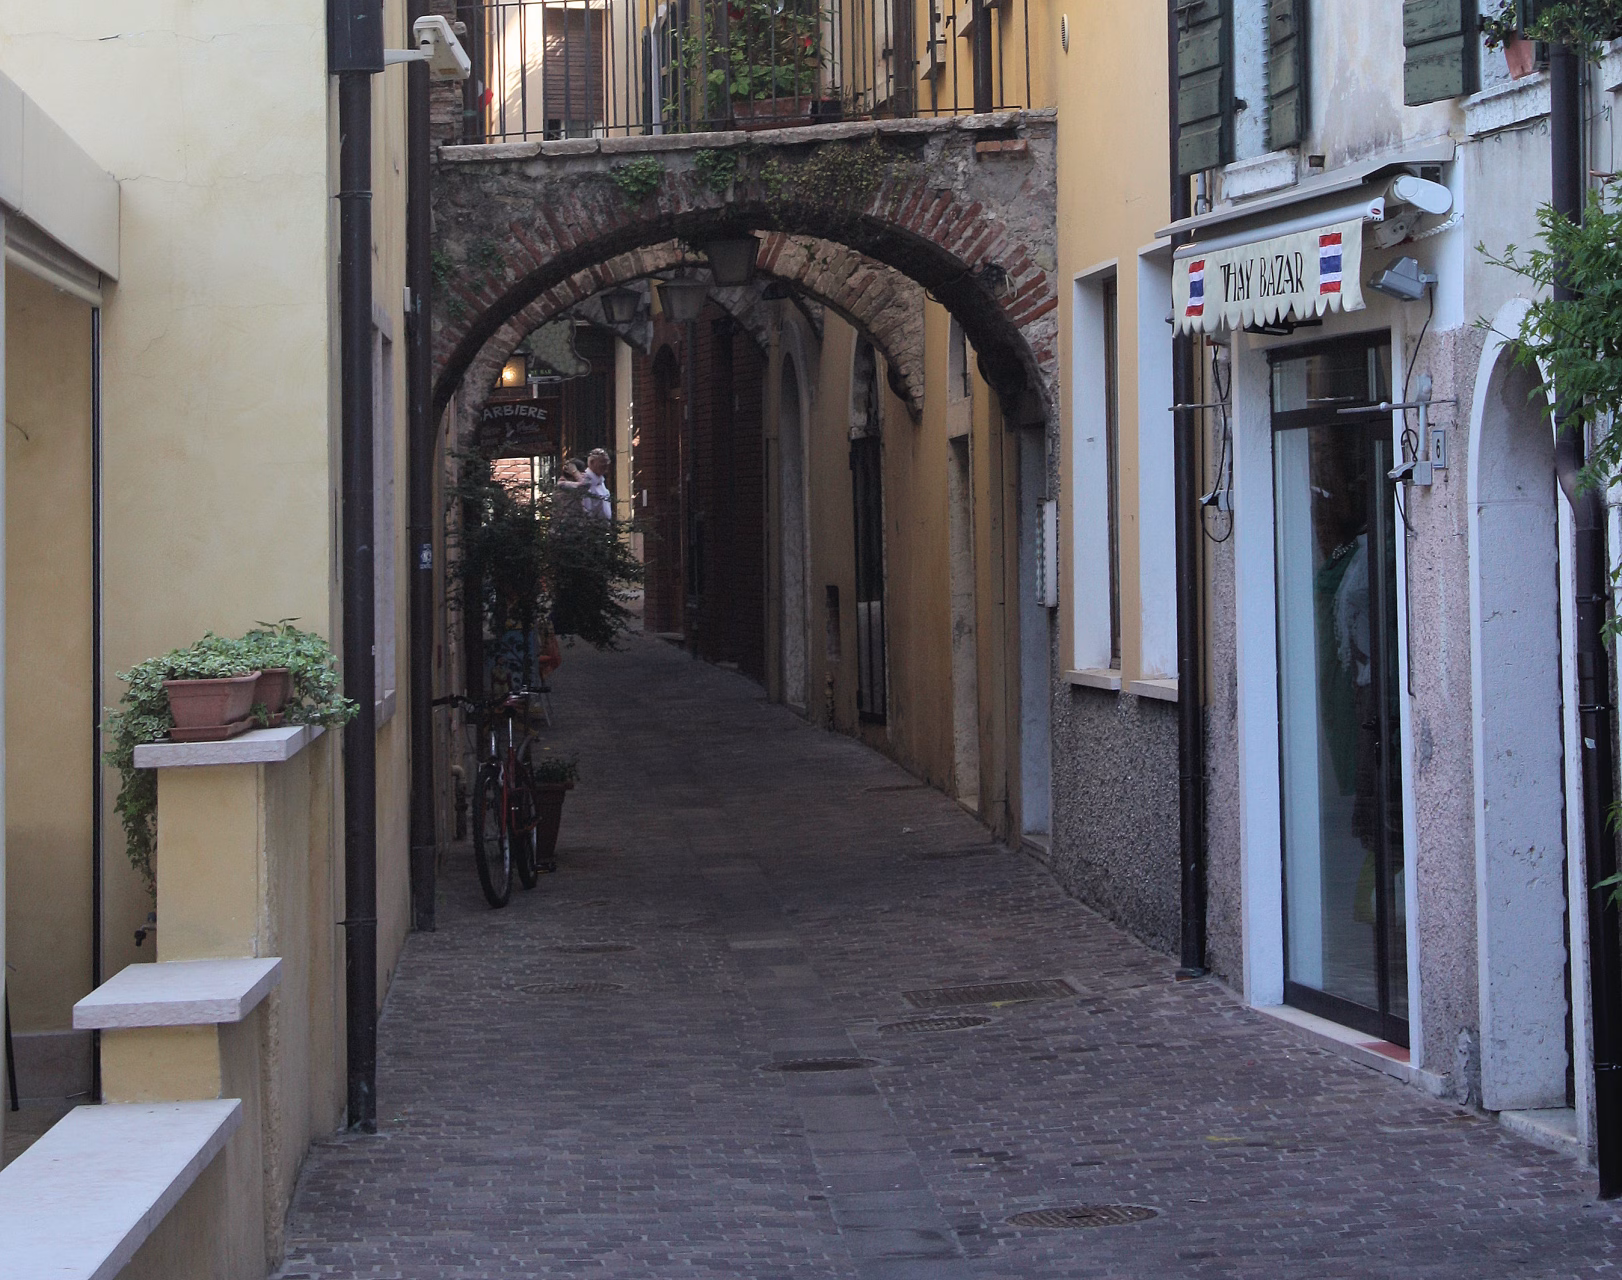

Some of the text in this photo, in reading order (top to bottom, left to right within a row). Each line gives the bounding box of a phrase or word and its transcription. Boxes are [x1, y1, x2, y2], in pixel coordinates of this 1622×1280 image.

[1219, 251, 1305, 303] THAY BAZAR
[481, 404, 548, 422] ARBIERE
[1436, 438, 1441, 459] 6
